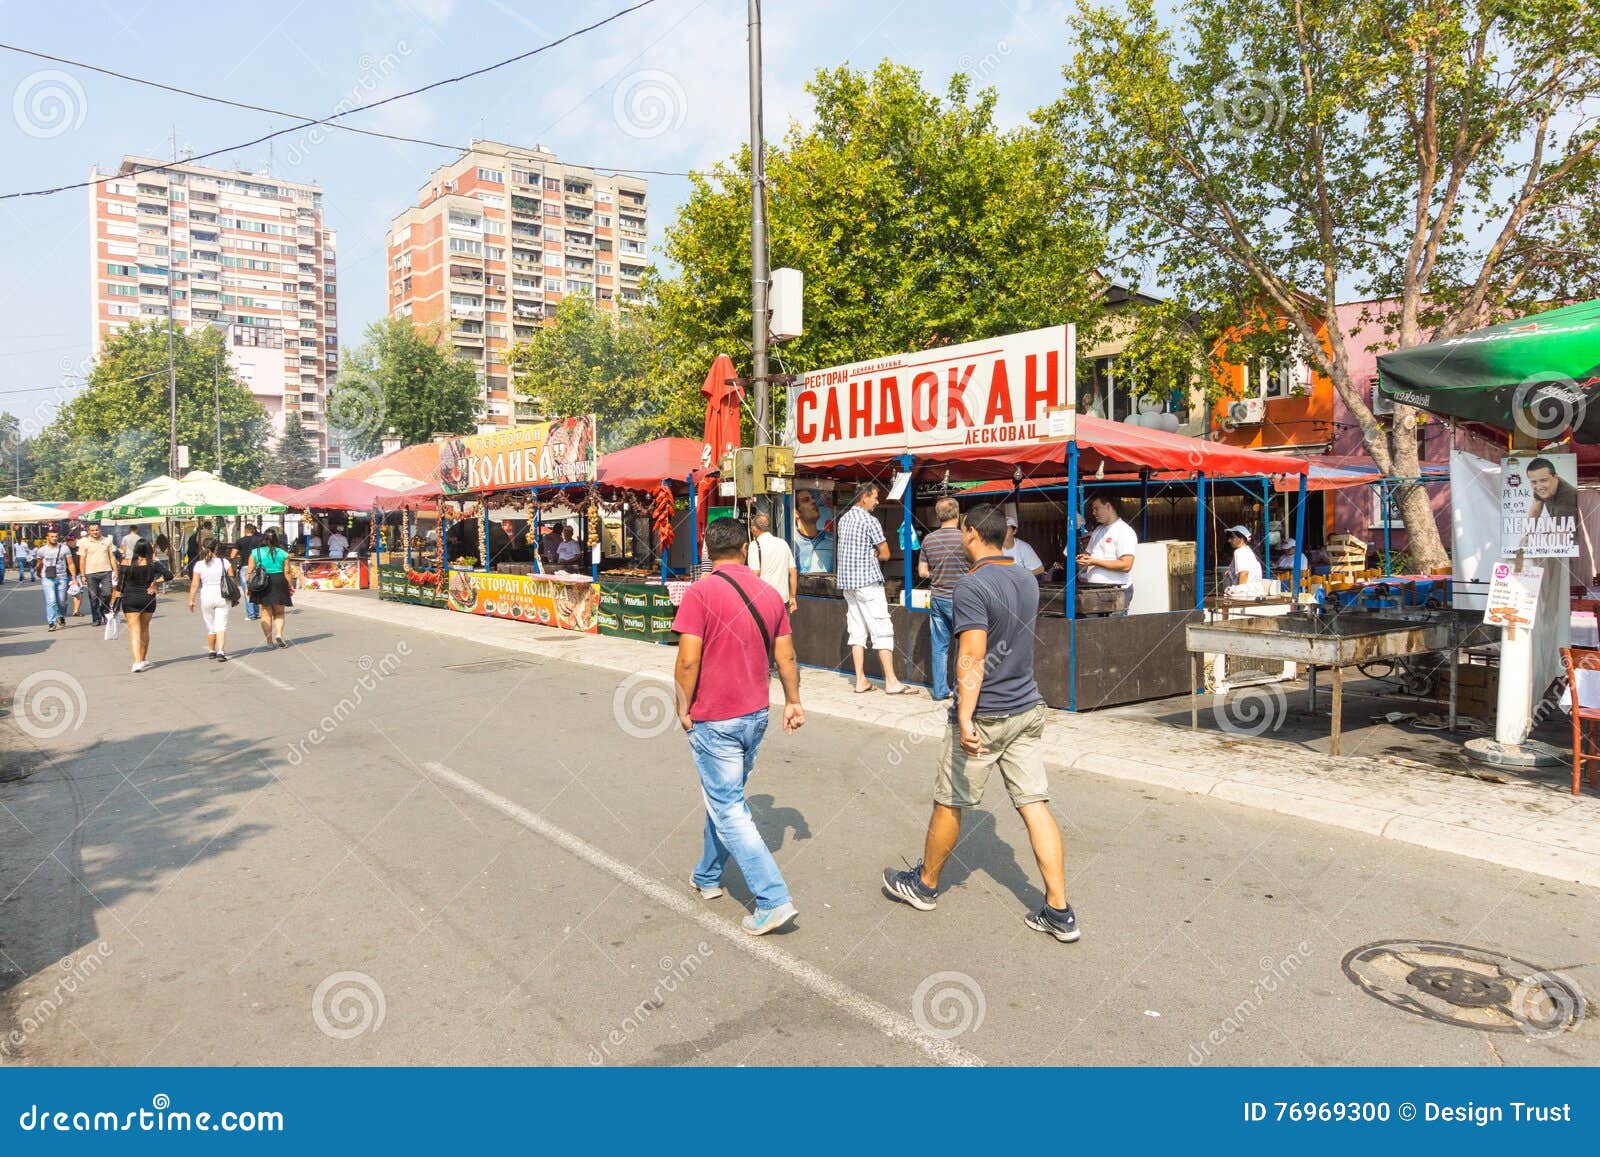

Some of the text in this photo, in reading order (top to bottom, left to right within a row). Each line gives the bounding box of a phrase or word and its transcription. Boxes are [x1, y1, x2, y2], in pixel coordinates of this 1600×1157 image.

[804, 368, 849, 390] РЕСТОРАН
[796, 350, 1058, 444] САНДОКАН
[476, 429, 542, 448] РЕСТОРАН
[965, 423, 1037, 445] ЛЕСКОВАЦ
[158, 506, 196, 516] WEIFERT
[1503, 516, 1577, 535] NEMANJA
[469, 575, 521, 594] РЕСТОРАН
